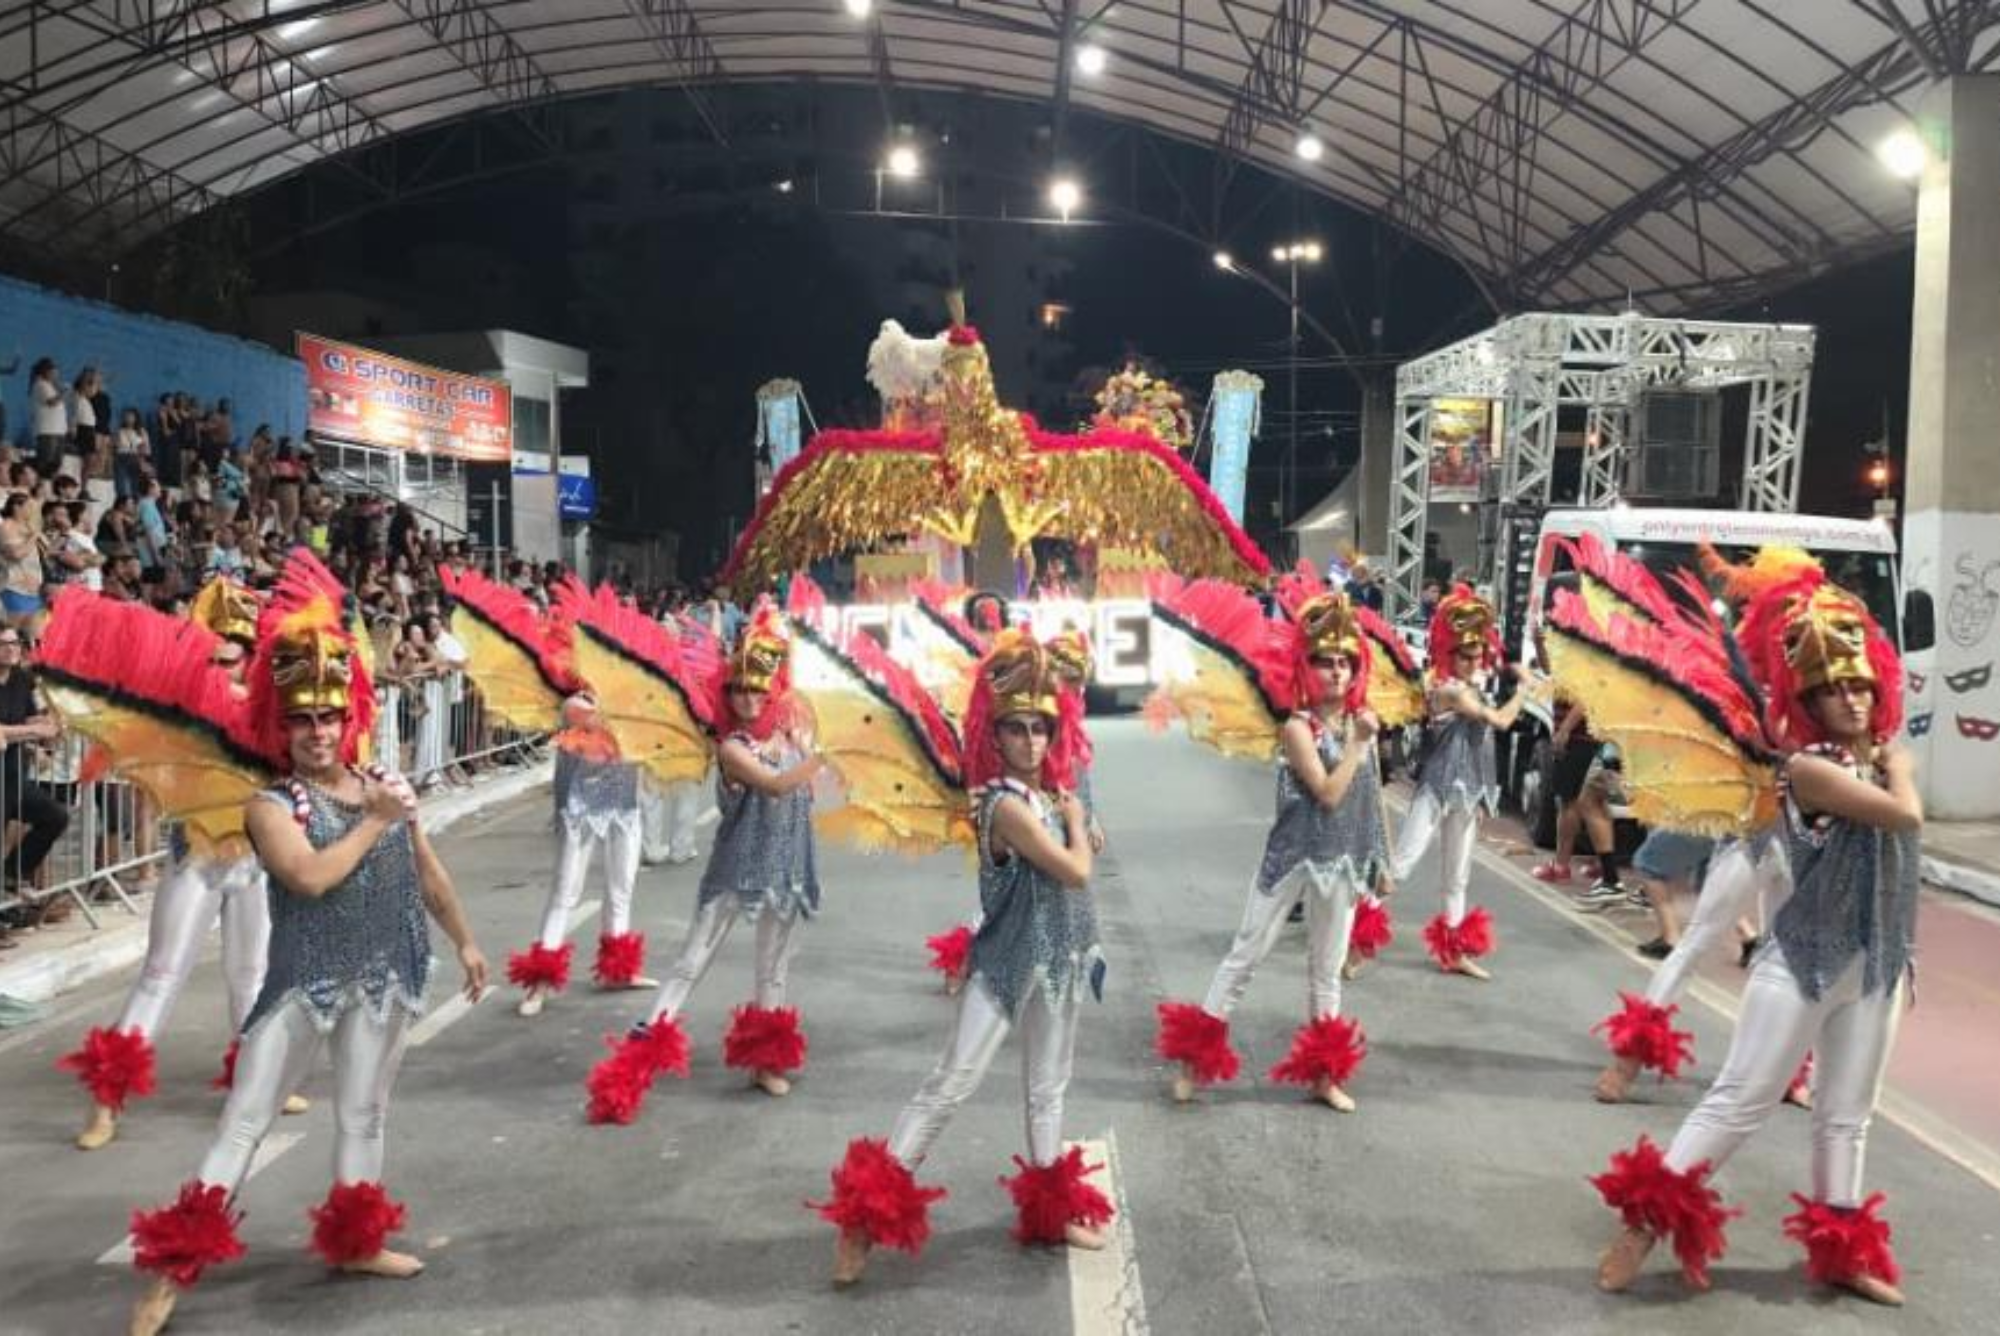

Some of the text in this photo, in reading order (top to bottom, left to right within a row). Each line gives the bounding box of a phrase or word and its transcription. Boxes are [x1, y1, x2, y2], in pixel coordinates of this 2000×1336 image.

[354, 358, 492, 408] SPORT CAR
[373, 389, 453, 419] ARRETAS
